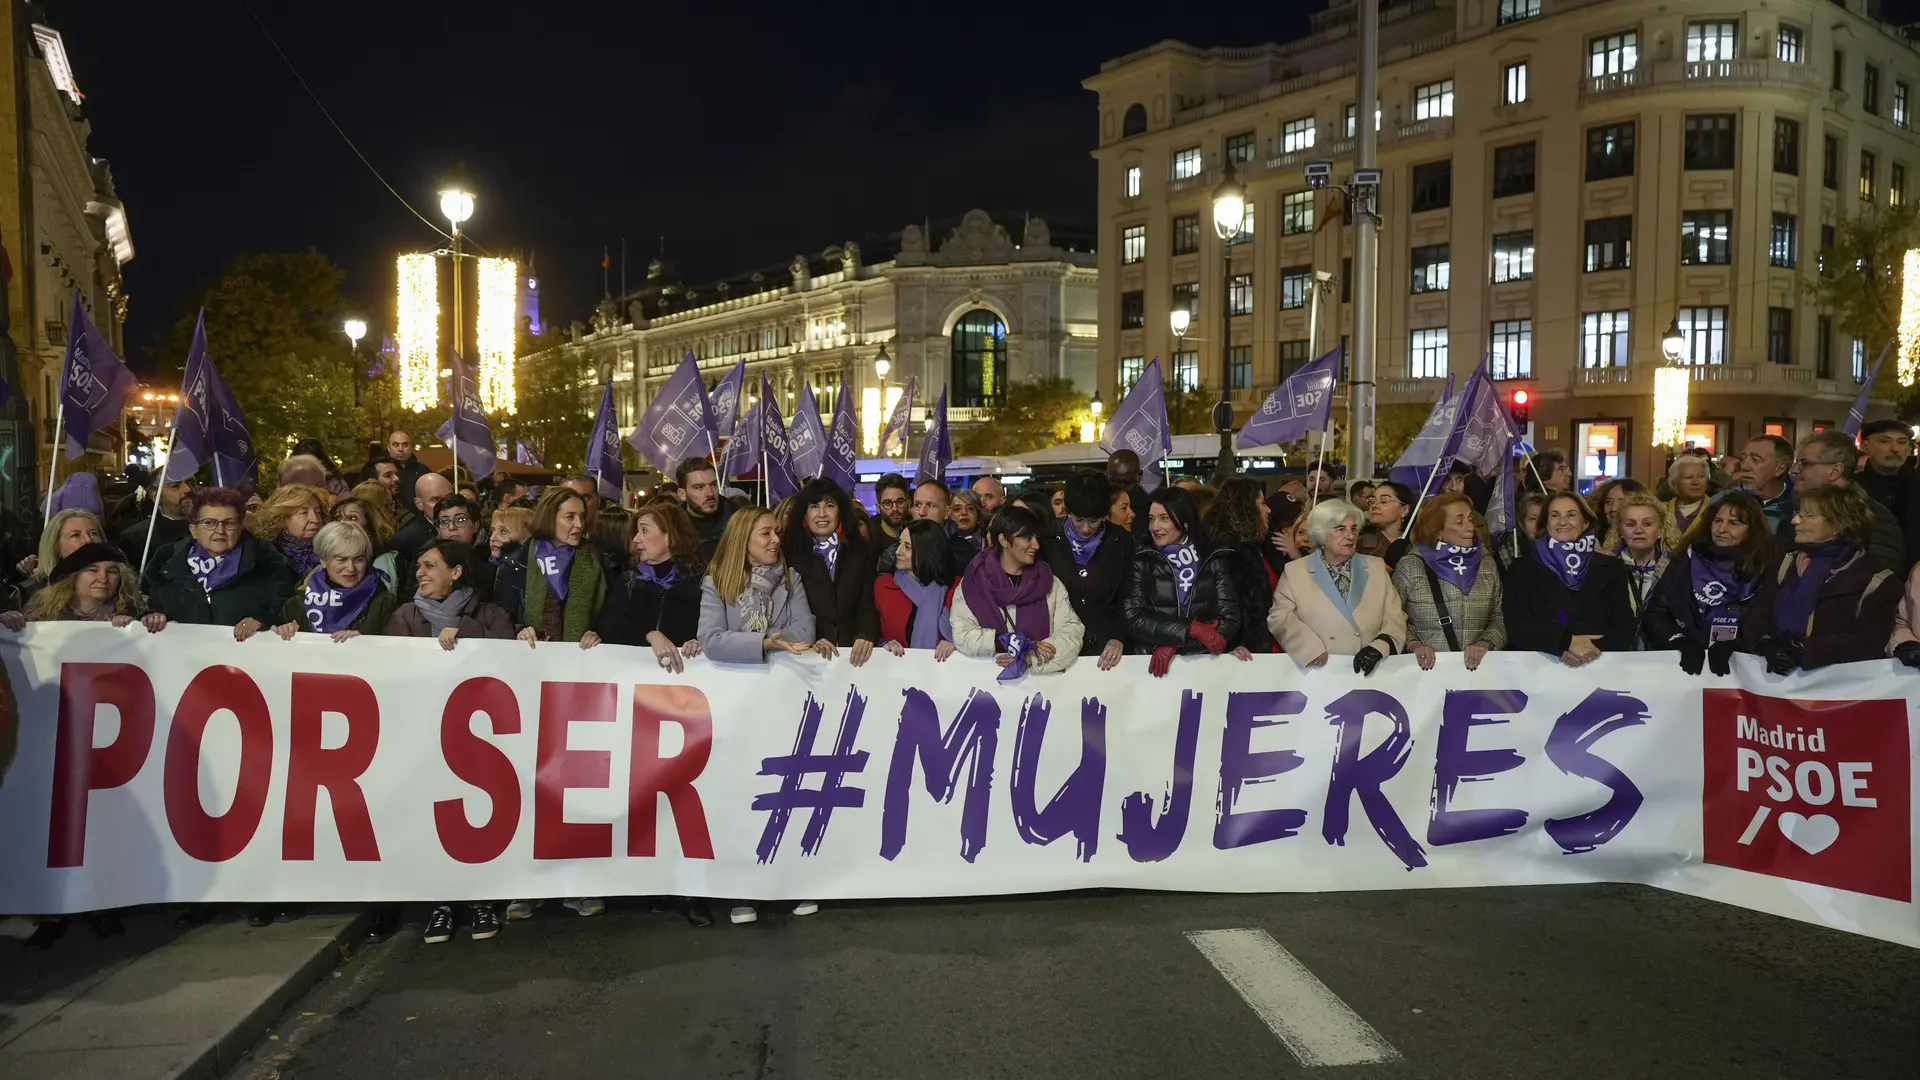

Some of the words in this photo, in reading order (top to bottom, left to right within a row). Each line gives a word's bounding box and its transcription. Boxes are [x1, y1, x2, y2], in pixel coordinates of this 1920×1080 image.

[1737, 715, 1826, 752] Madrid
[47, 662, 380, 868] POR
[434, 676, 715, 864] SER
[752, 683, 1652, 872] #MUJERES
[1737, 747, 1878, 808] PSOE
